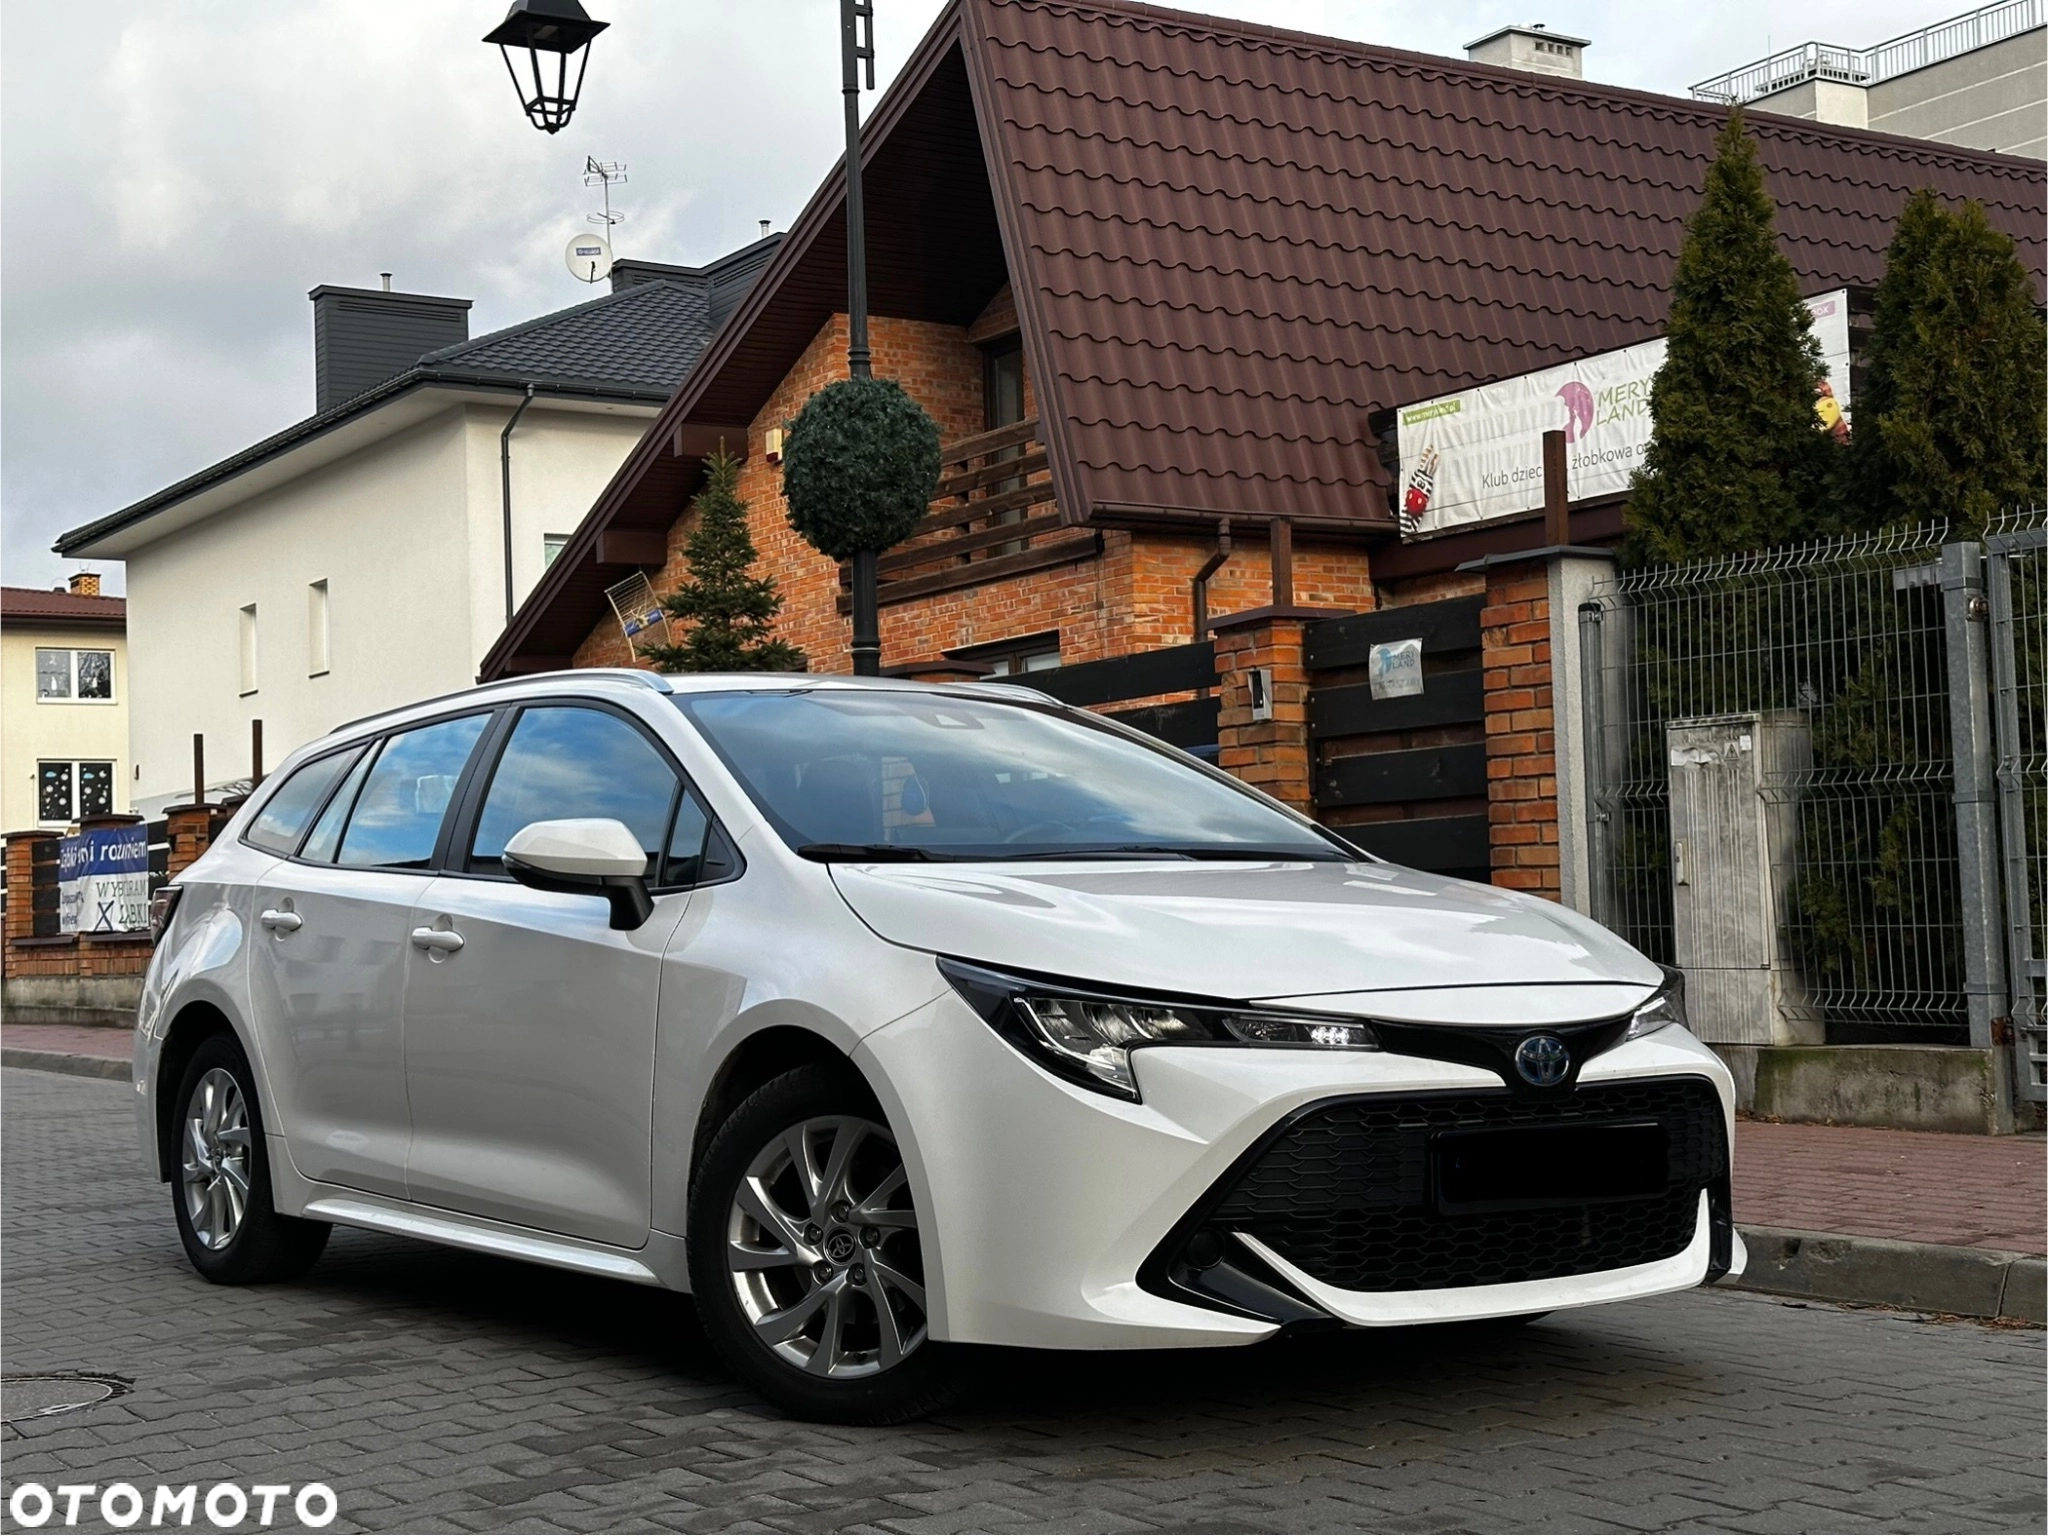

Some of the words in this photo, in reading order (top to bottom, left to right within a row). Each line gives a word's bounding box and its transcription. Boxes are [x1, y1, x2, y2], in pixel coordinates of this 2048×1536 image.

[1599, 376, 1650, 408] MERY
[1596, 398, 1651, 426] LAND
[1482, 472, 1509, 489] Klub
[1512, 465, 1543, 484] dziec
[1571, 446, 1633, 471] żłobkowa
[1393, 650, 1414, 660] MERY
[1393, 659, 1415, 669] LAND
